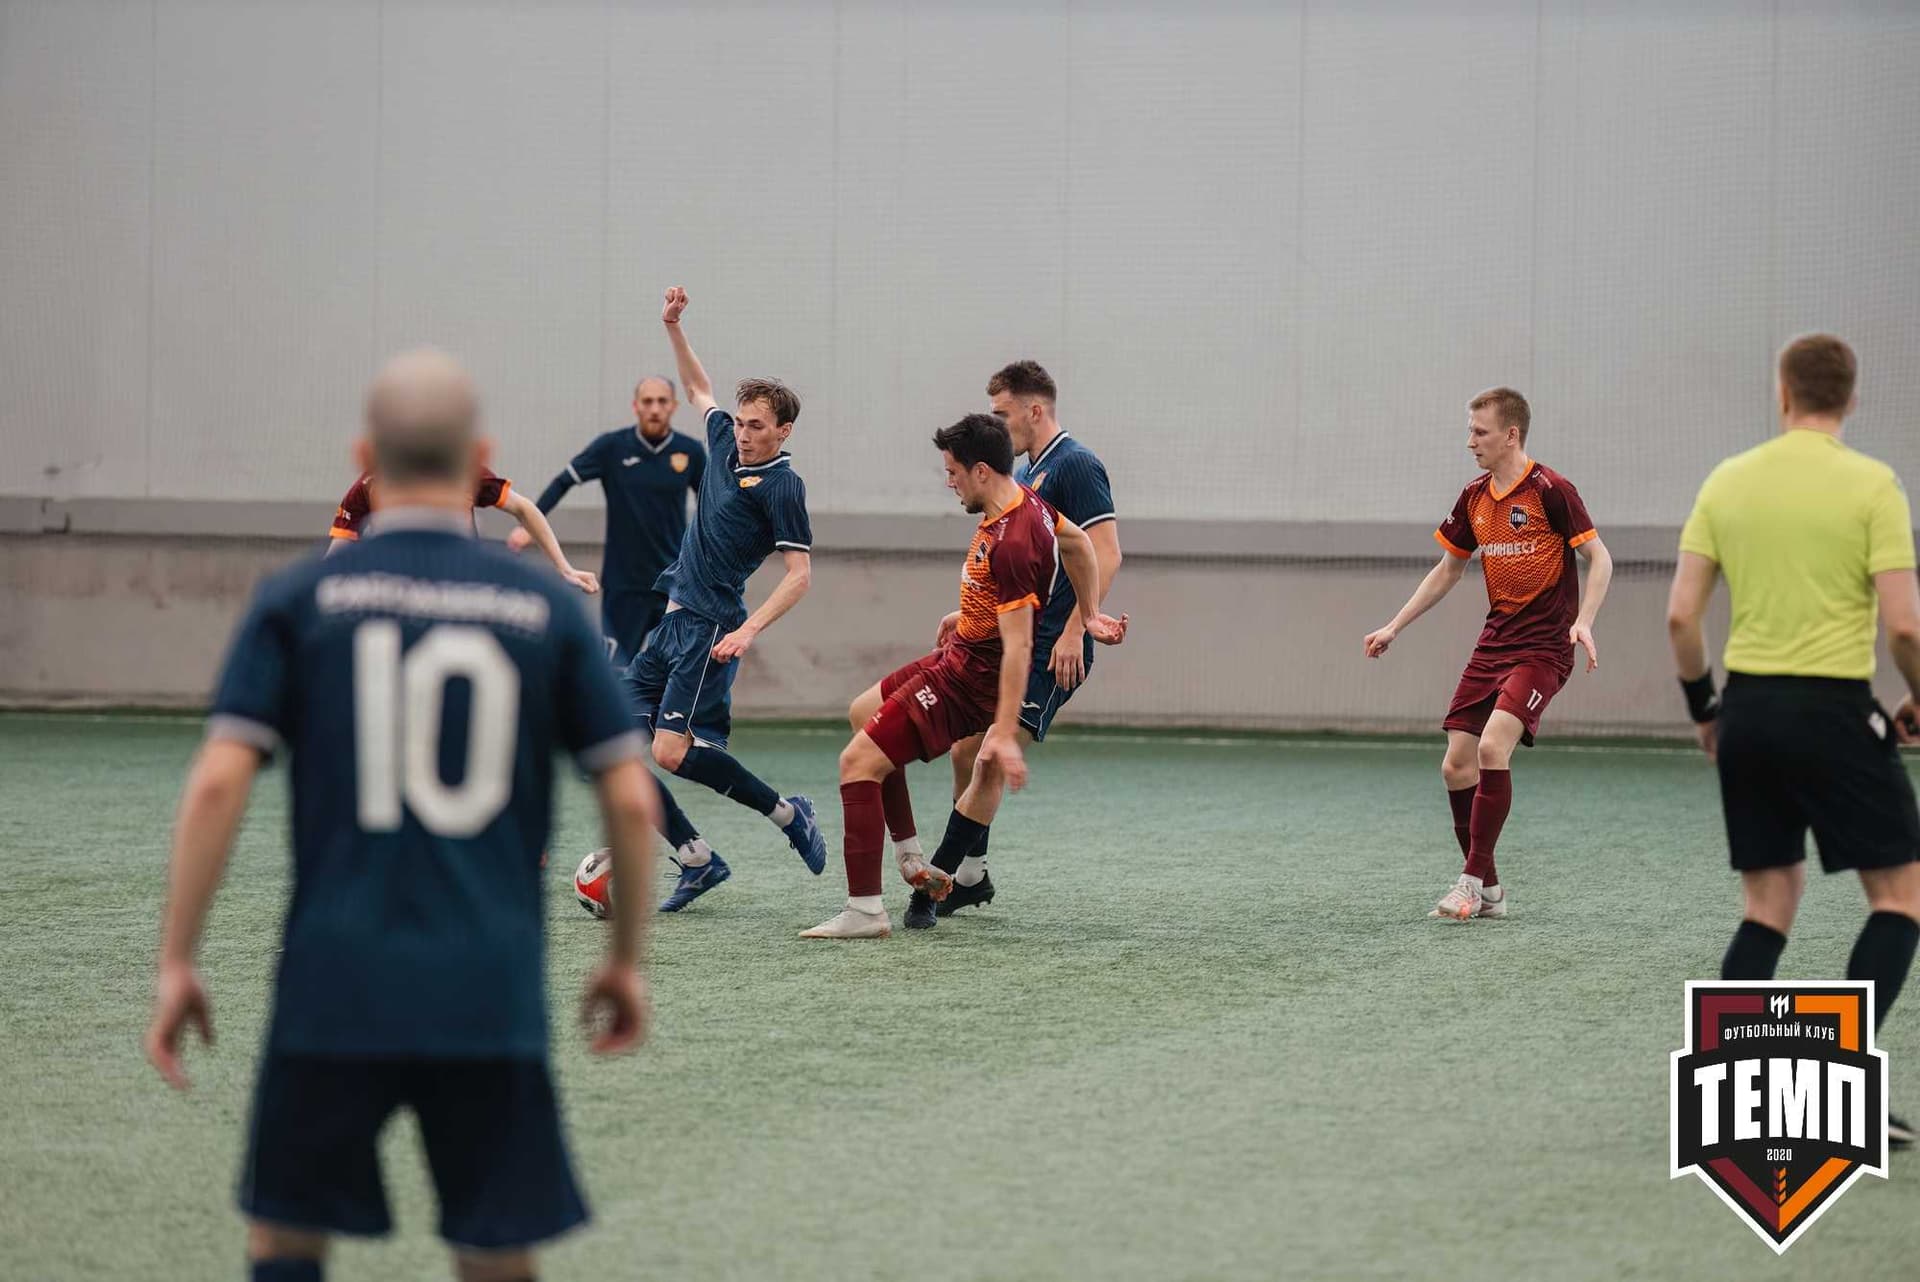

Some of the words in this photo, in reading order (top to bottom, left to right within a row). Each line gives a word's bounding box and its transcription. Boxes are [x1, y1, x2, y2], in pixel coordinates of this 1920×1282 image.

[915, 685, 938, 710] 22
[1527, 688, 1543, 710] 17
[354, 619, 521, 838] 10
